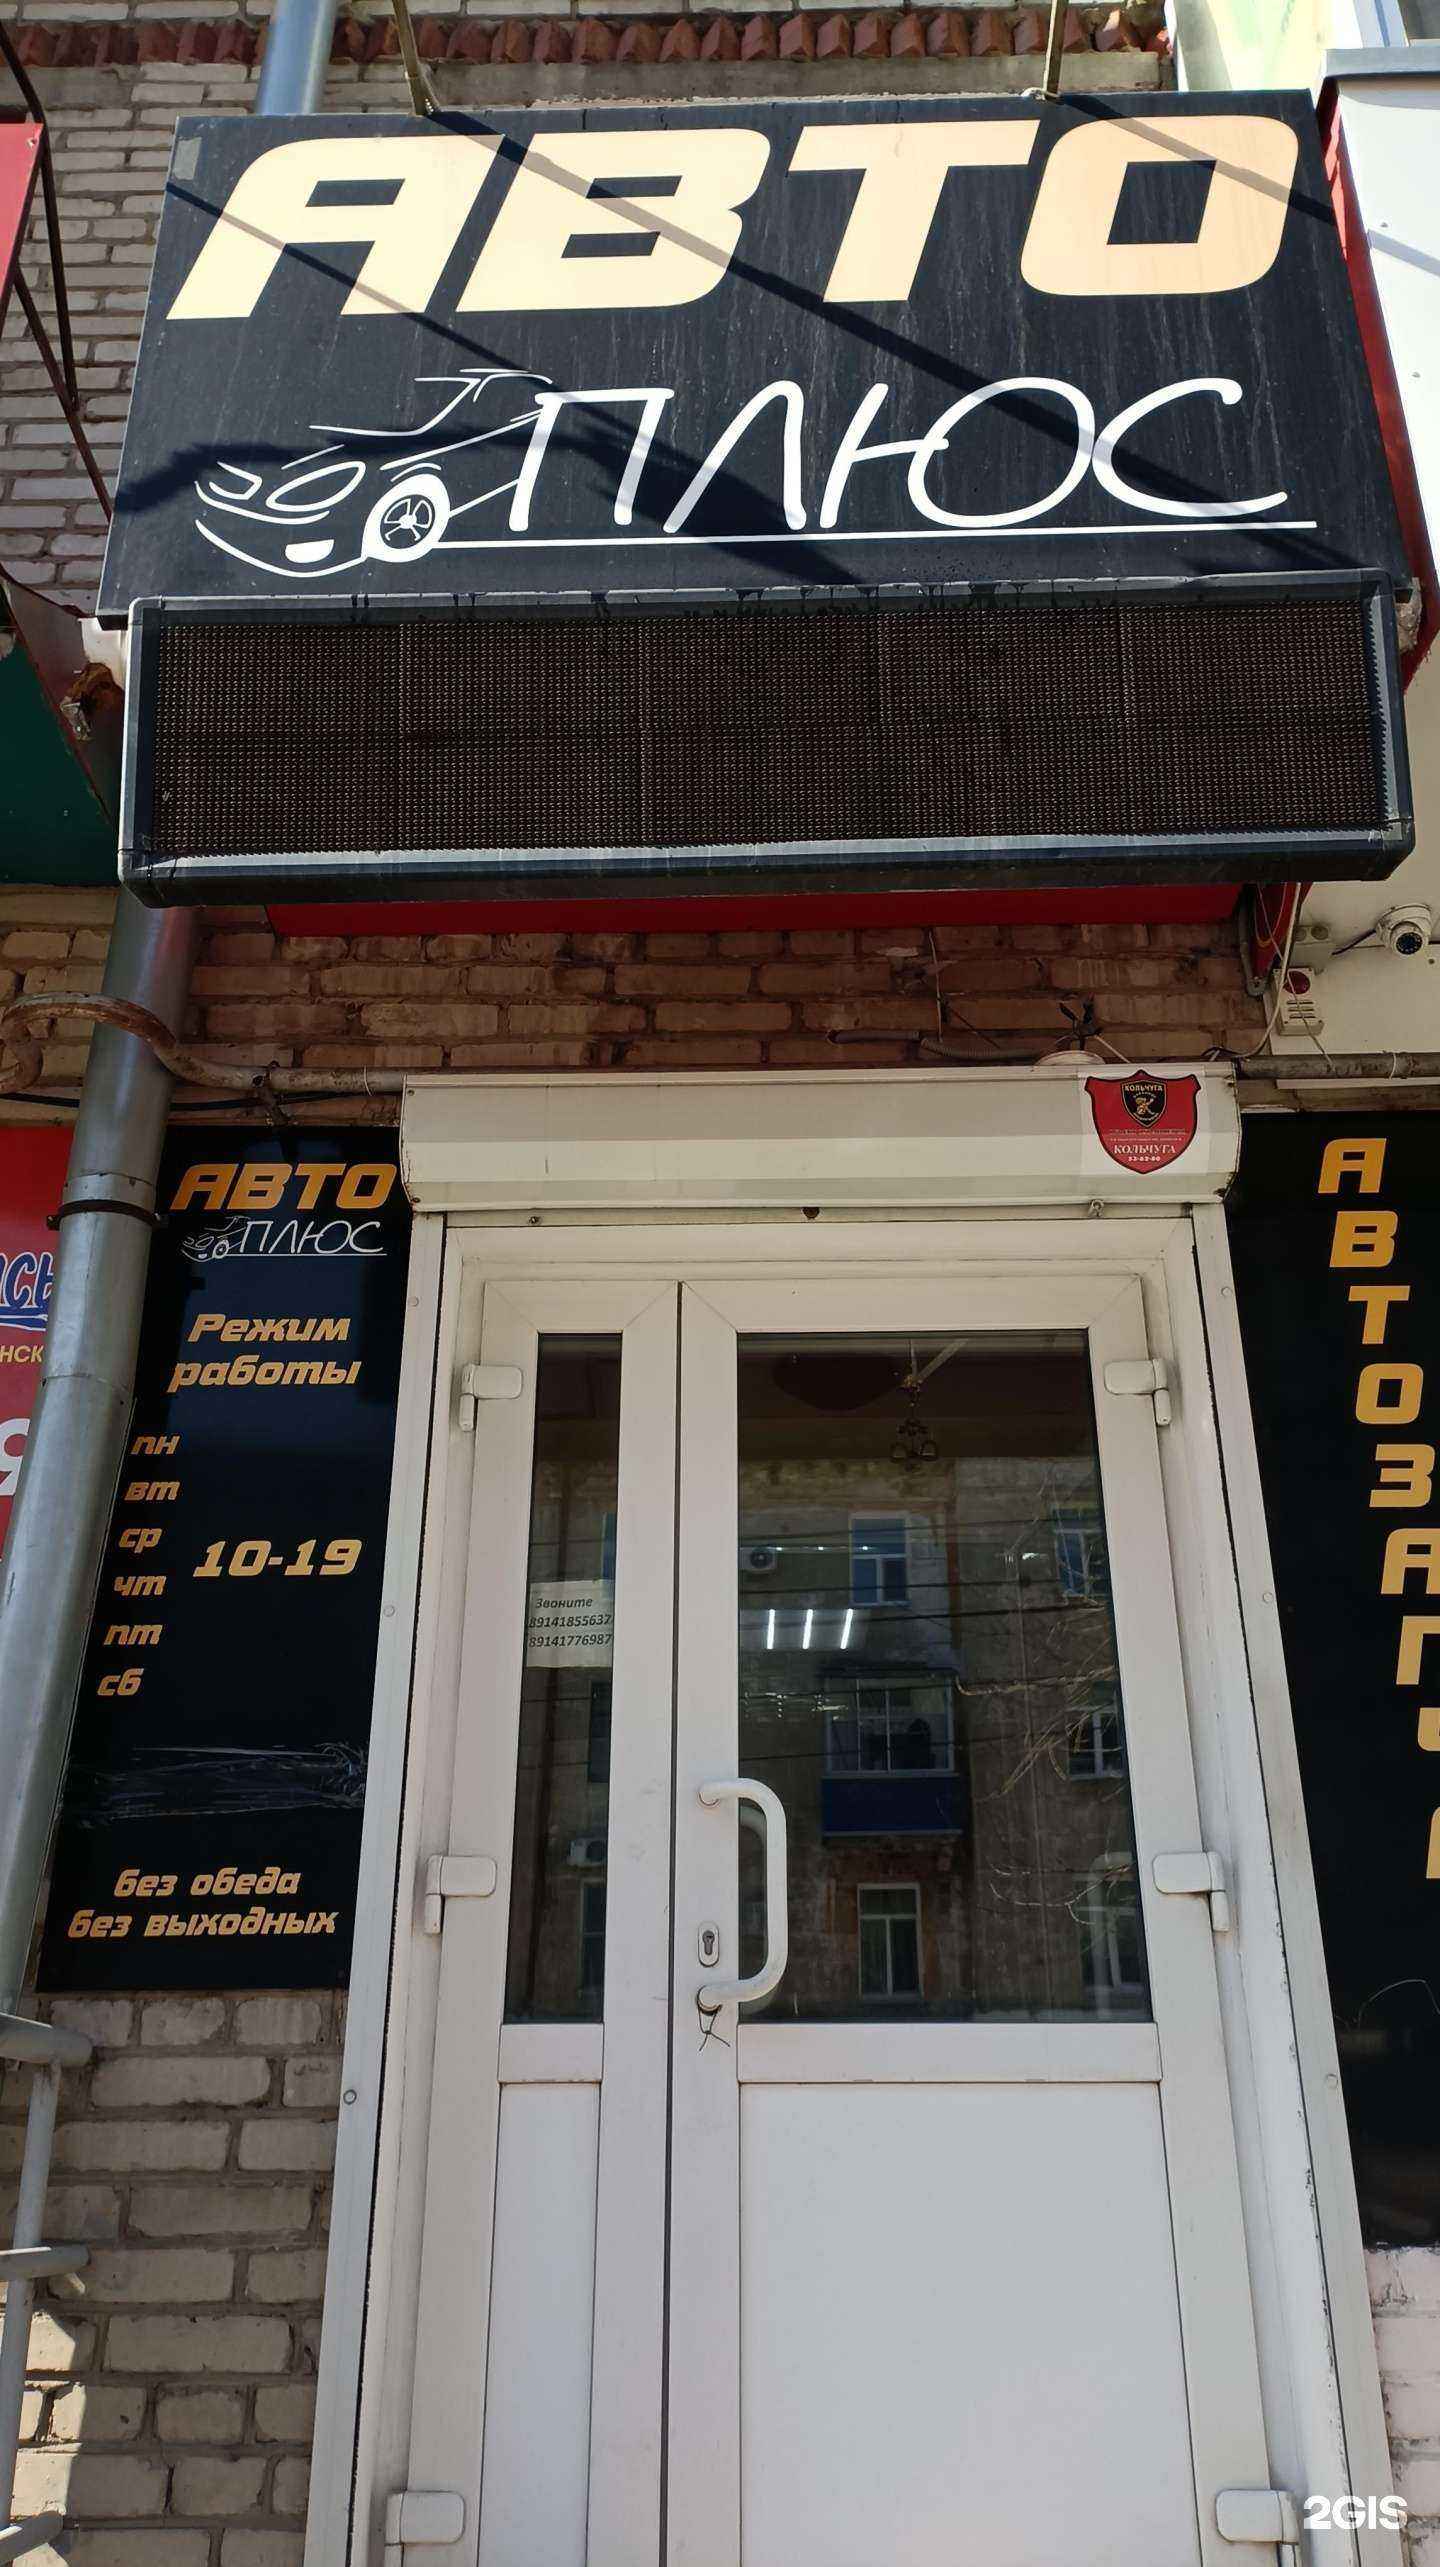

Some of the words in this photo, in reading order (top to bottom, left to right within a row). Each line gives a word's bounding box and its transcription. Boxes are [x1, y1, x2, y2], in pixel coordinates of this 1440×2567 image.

[166, 115, 1298, 320] АВТО
[508, 376, 1287, 532] ПЛЮС
[1113, 1144, 1177, 1155] КОЛЬЧУГА
[170, 1163, 398, 1211] АВТО
[238, 1219, 384, 1254] ПЛЮС
[188, 1313, 351, 1343] Режим
[166, 1354, 362, 1393] работы
[131, 1434, 182, 1455] пн
[124, 1480, 181, 1501] вт
[1317, 1137, 1440, 1880] АВТОЗАП
[118, 1527, 163, 1554] ср
[192, 1539, 364, 1578] 10-19
[113, 1575, 167, 1597] чт
[535, 1598, 593, 1609] Звоните
[104, 1624, 163, 1646] пт
[527, 1614, 612, 1629] 89141855637
[527, 1633, 612, 1648] 89141776987
[97, 1668, 144, 1696] сб
[114, 1868, 177, 1898] без
[191, 1867, 302, 1896] обеда
[68, 1909, 131, 1939] без
[144, 1907, 339, 1938] выходных
